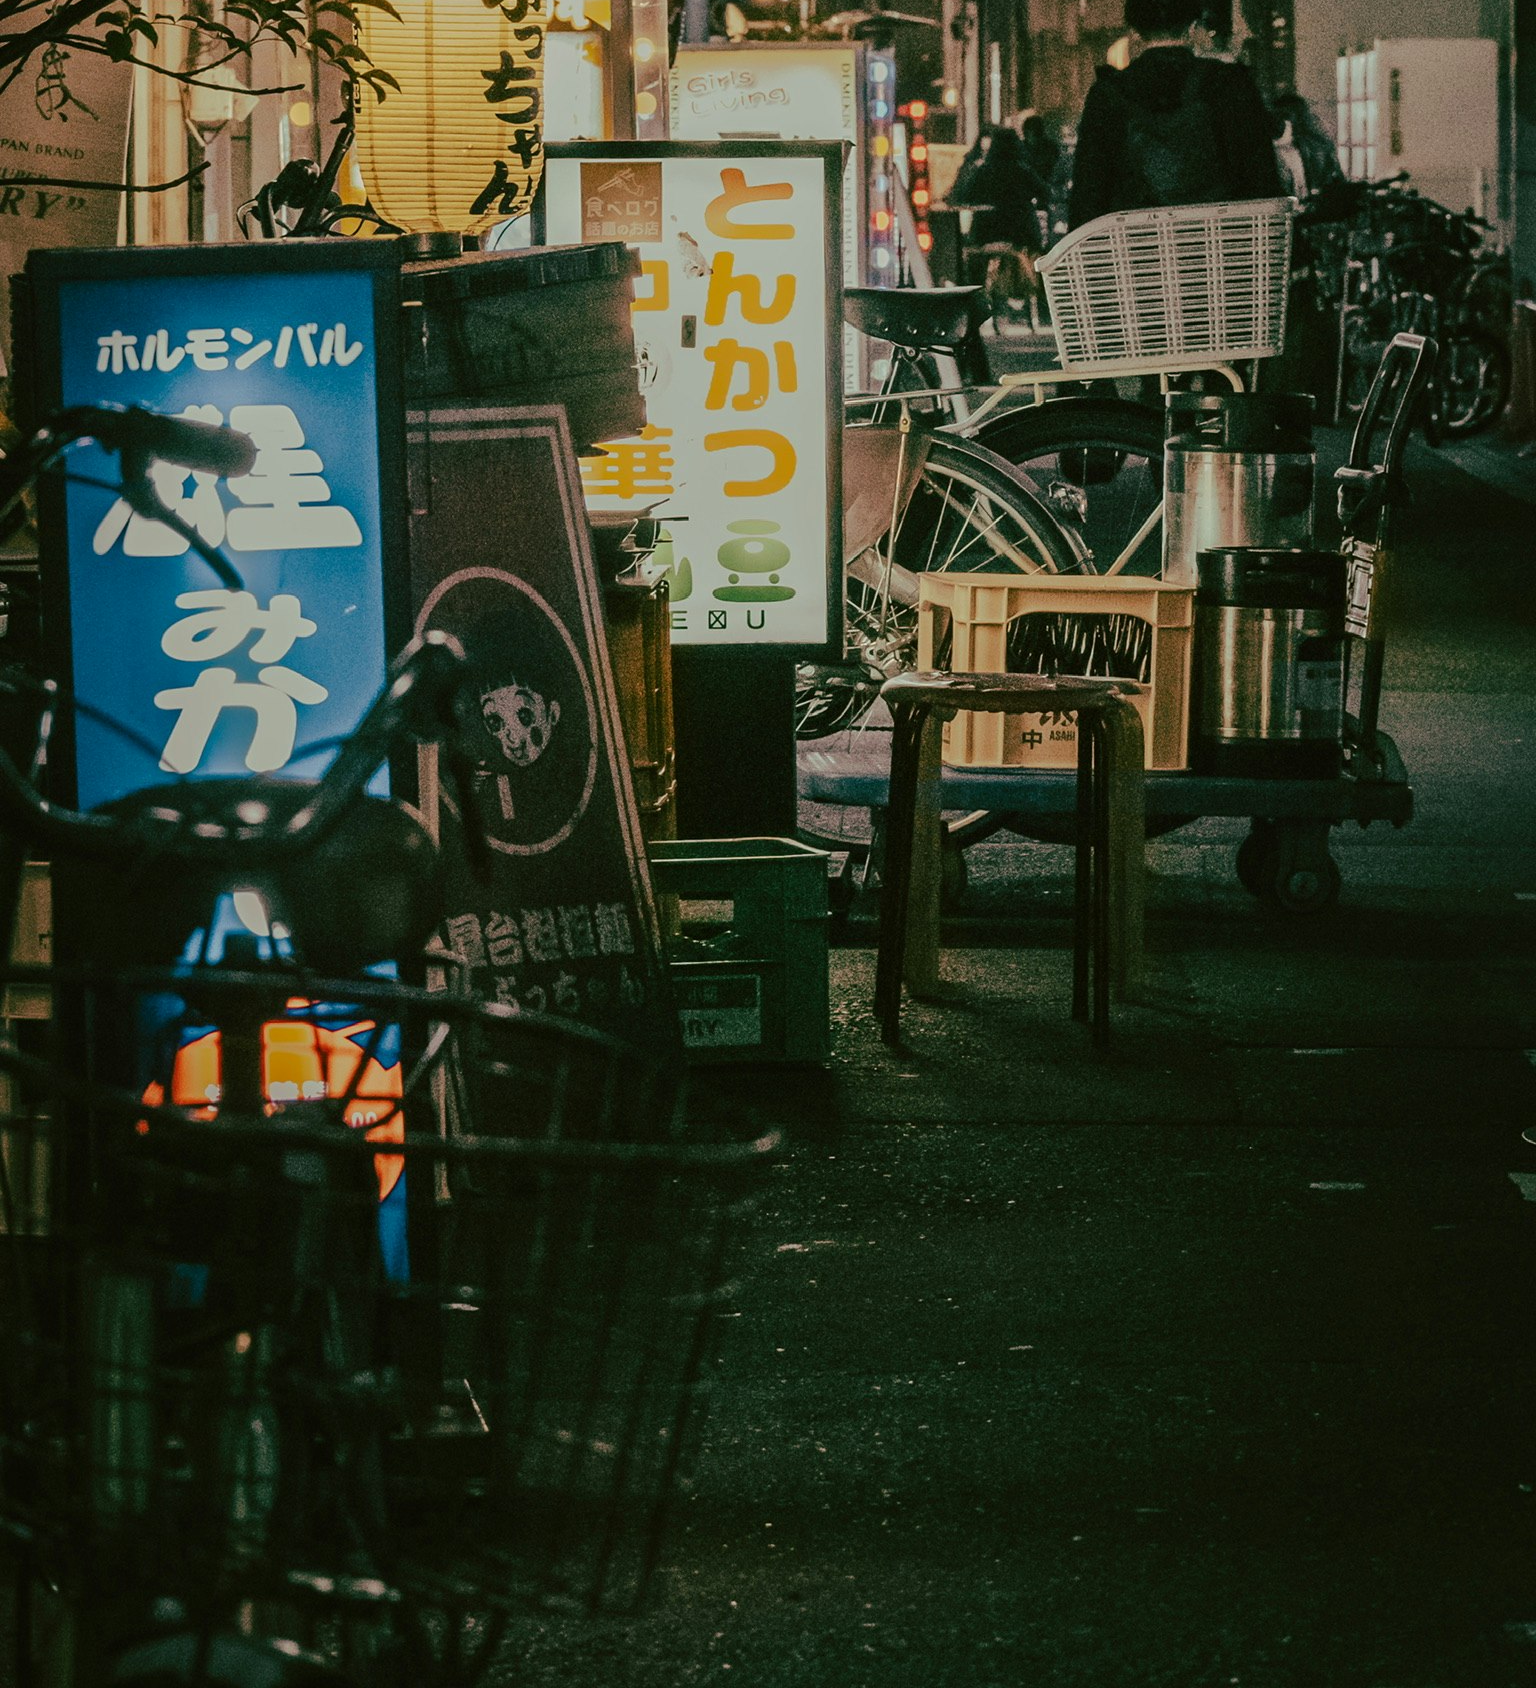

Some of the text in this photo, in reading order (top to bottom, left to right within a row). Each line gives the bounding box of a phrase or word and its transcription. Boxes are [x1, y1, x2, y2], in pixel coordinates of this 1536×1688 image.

[687, 70, 752, 93] Girls
[691, 88, 788, 116] Living
[35, 143, 85, 160] BRAND
[585, 196, 659, 219] 食べログ
[704, 167, 799, 498] とんかつ
[96, 322, 363, 374] ホルモンバル
[1021, 728, 1043, 750] 中
